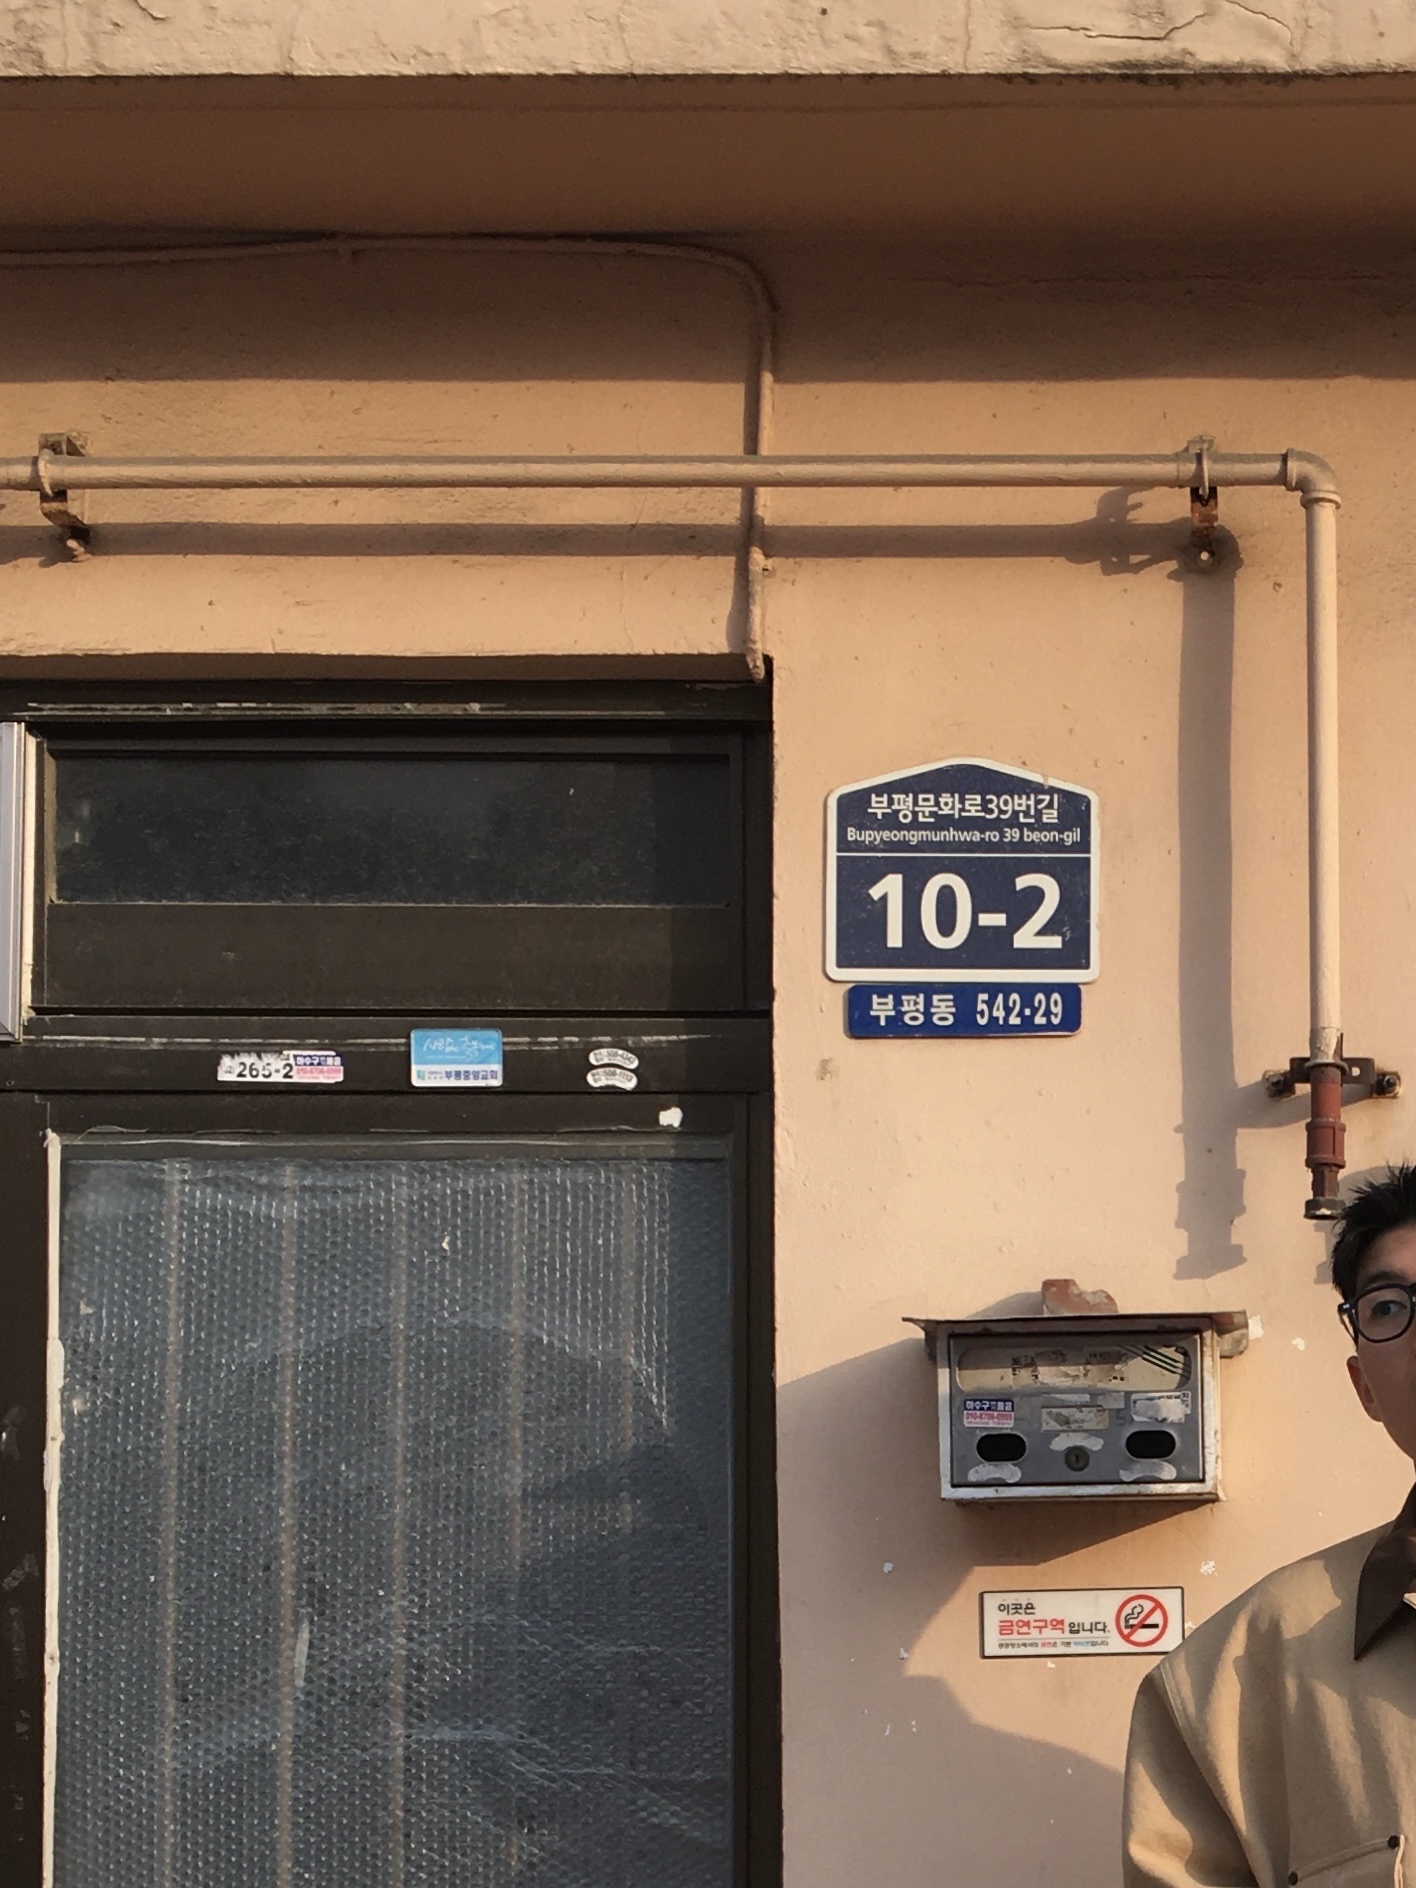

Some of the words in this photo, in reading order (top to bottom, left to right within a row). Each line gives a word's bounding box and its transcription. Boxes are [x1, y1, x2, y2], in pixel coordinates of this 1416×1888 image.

[867, 793, 1059, 823] 부평문화로39번길
[847, 827, 1000, 845] Bupyeongmunhwa-ro
[1002, 828, 1020, 842] 39
[1023, 827, 1081, 846] beon-gil
[868, 872, 1063, 950] 10-2
[869, 993, 956, 1026] 부평동
[975, 992, 1063, 1026] 542-29
[236, 1061, 294, 1079] 265-2
[444, 1069, 498, 1081] 부평중앙교회
[997, 1601, 1036, 1616] 이곳은
[998, 1618, 1065, 1636] 금연구역
[1068, 1621, 1111, 1635] 입니다.
